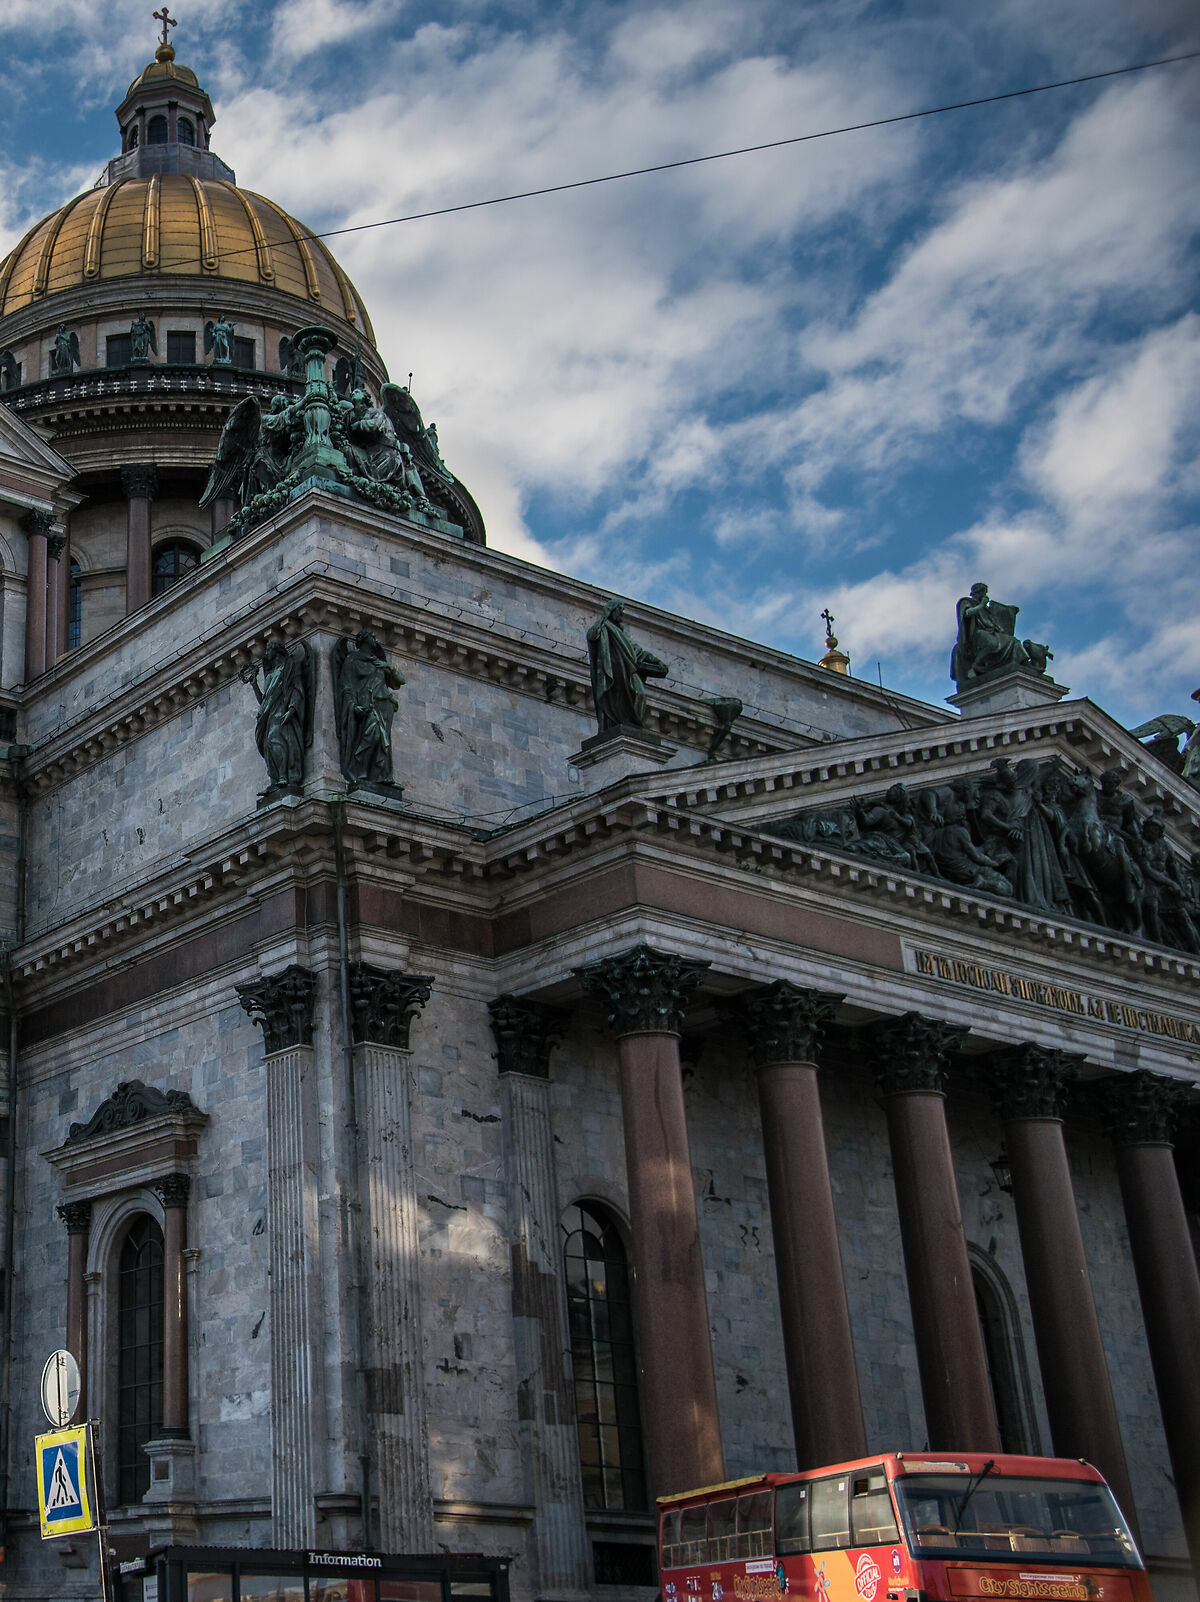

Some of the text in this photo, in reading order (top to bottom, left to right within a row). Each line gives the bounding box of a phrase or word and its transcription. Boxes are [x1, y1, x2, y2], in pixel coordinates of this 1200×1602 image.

[308, 1552, 382, 1567] Information
[980, 1577, 1088, 1600] City Sightseeing
